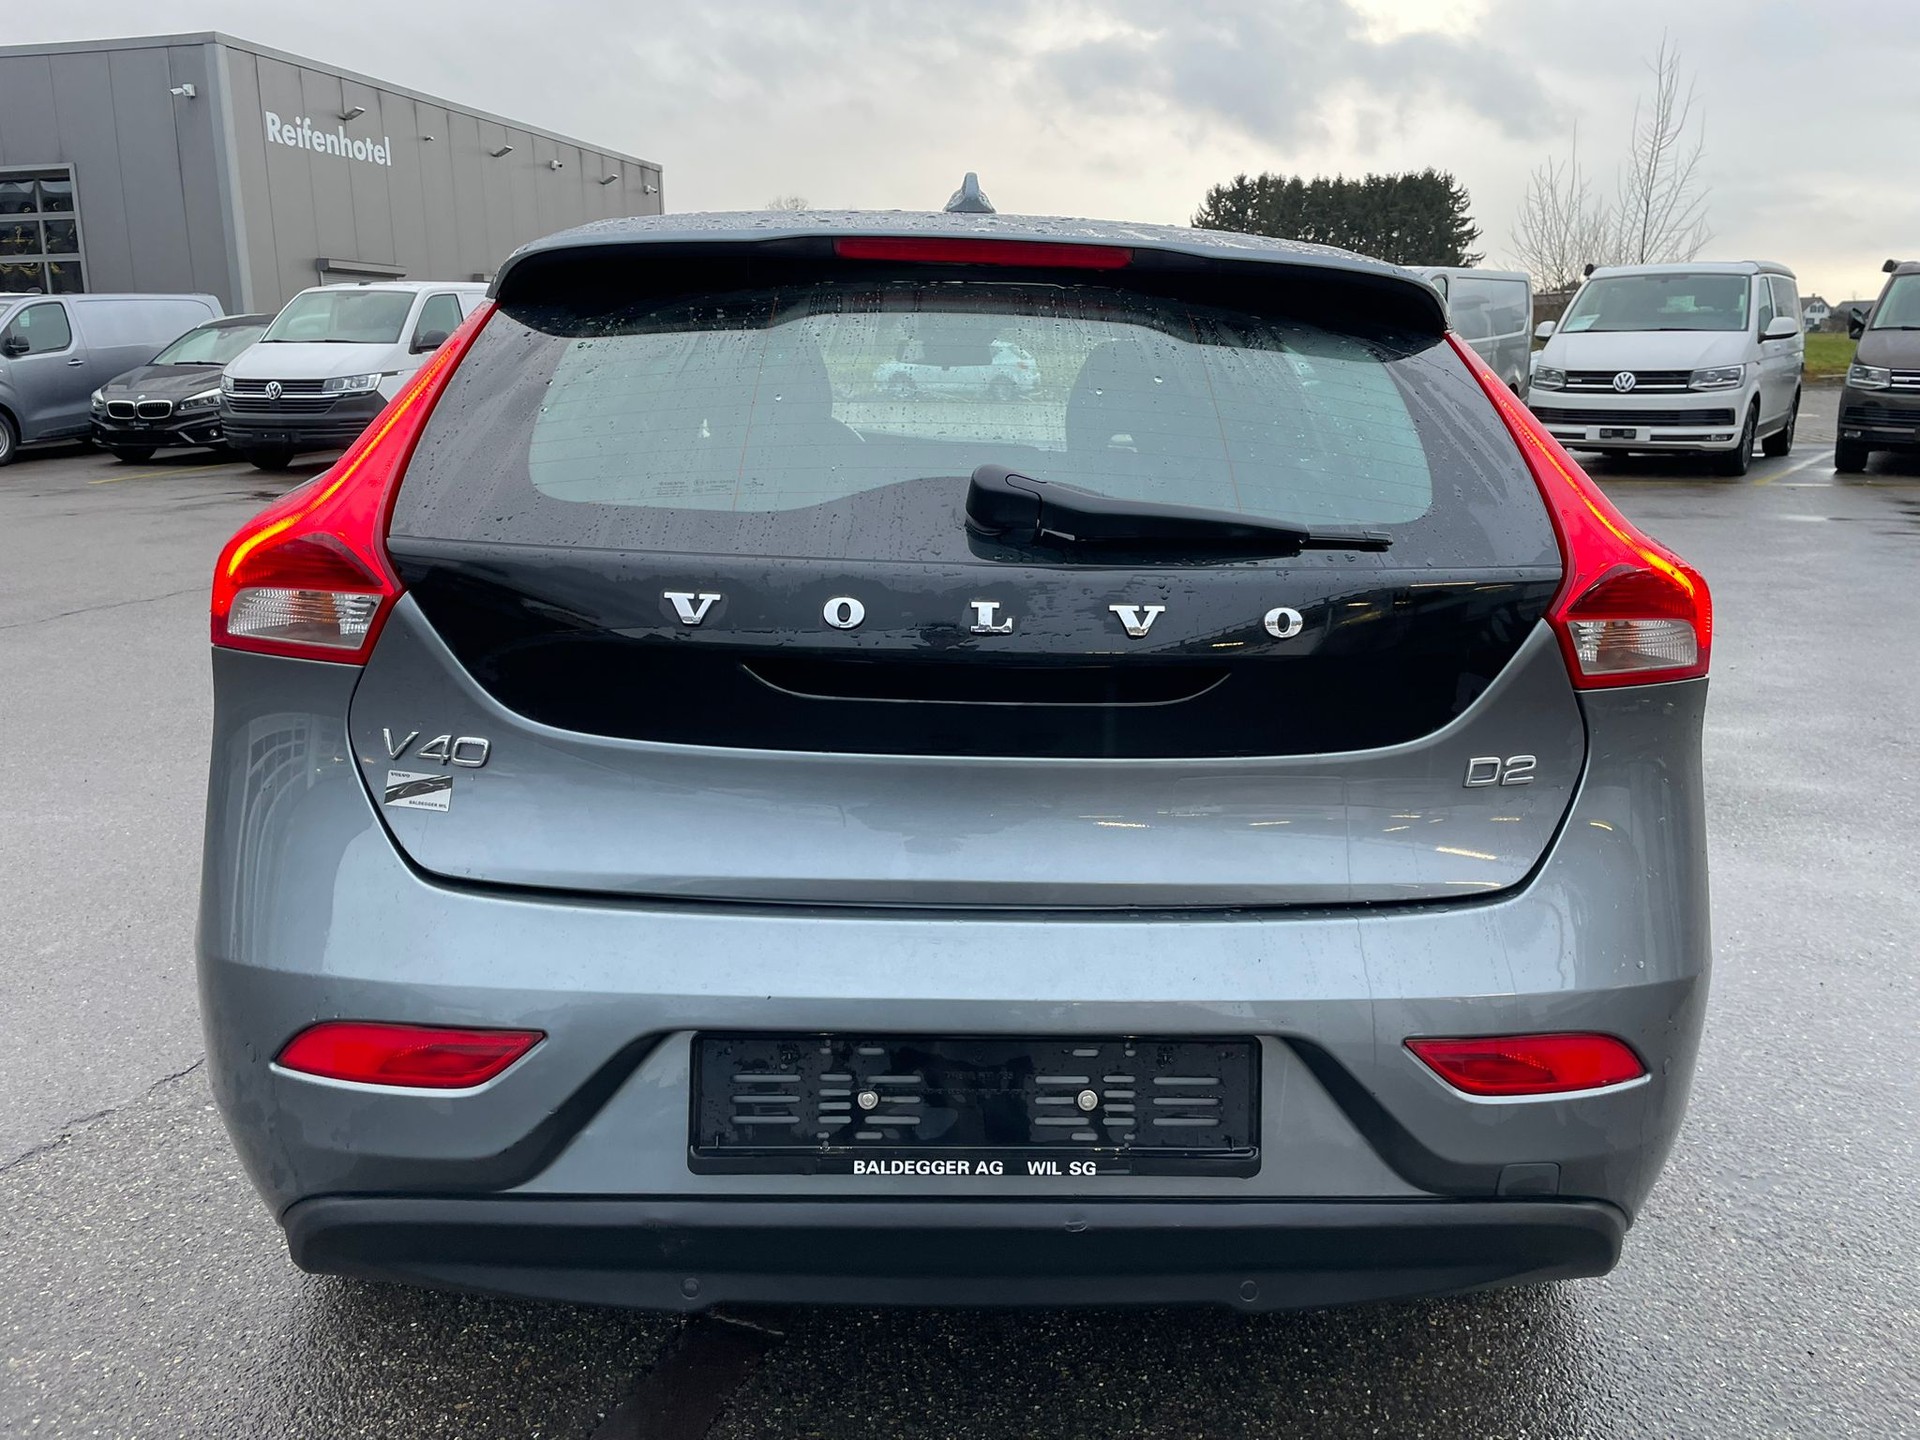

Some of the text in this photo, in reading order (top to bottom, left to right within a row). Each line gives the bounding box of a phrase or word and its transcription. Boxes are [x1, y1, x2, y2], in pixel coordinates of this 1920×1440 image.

[265, 111, 392, 166] Reifenhotel
[663, 592, 1304, 639] VOLVO
[382, 728, 491, 768] V40
[1464, 754, 1537, 787] D2
[853, 1160, 1097, 1176] BALDEGGER AG WIL SG
